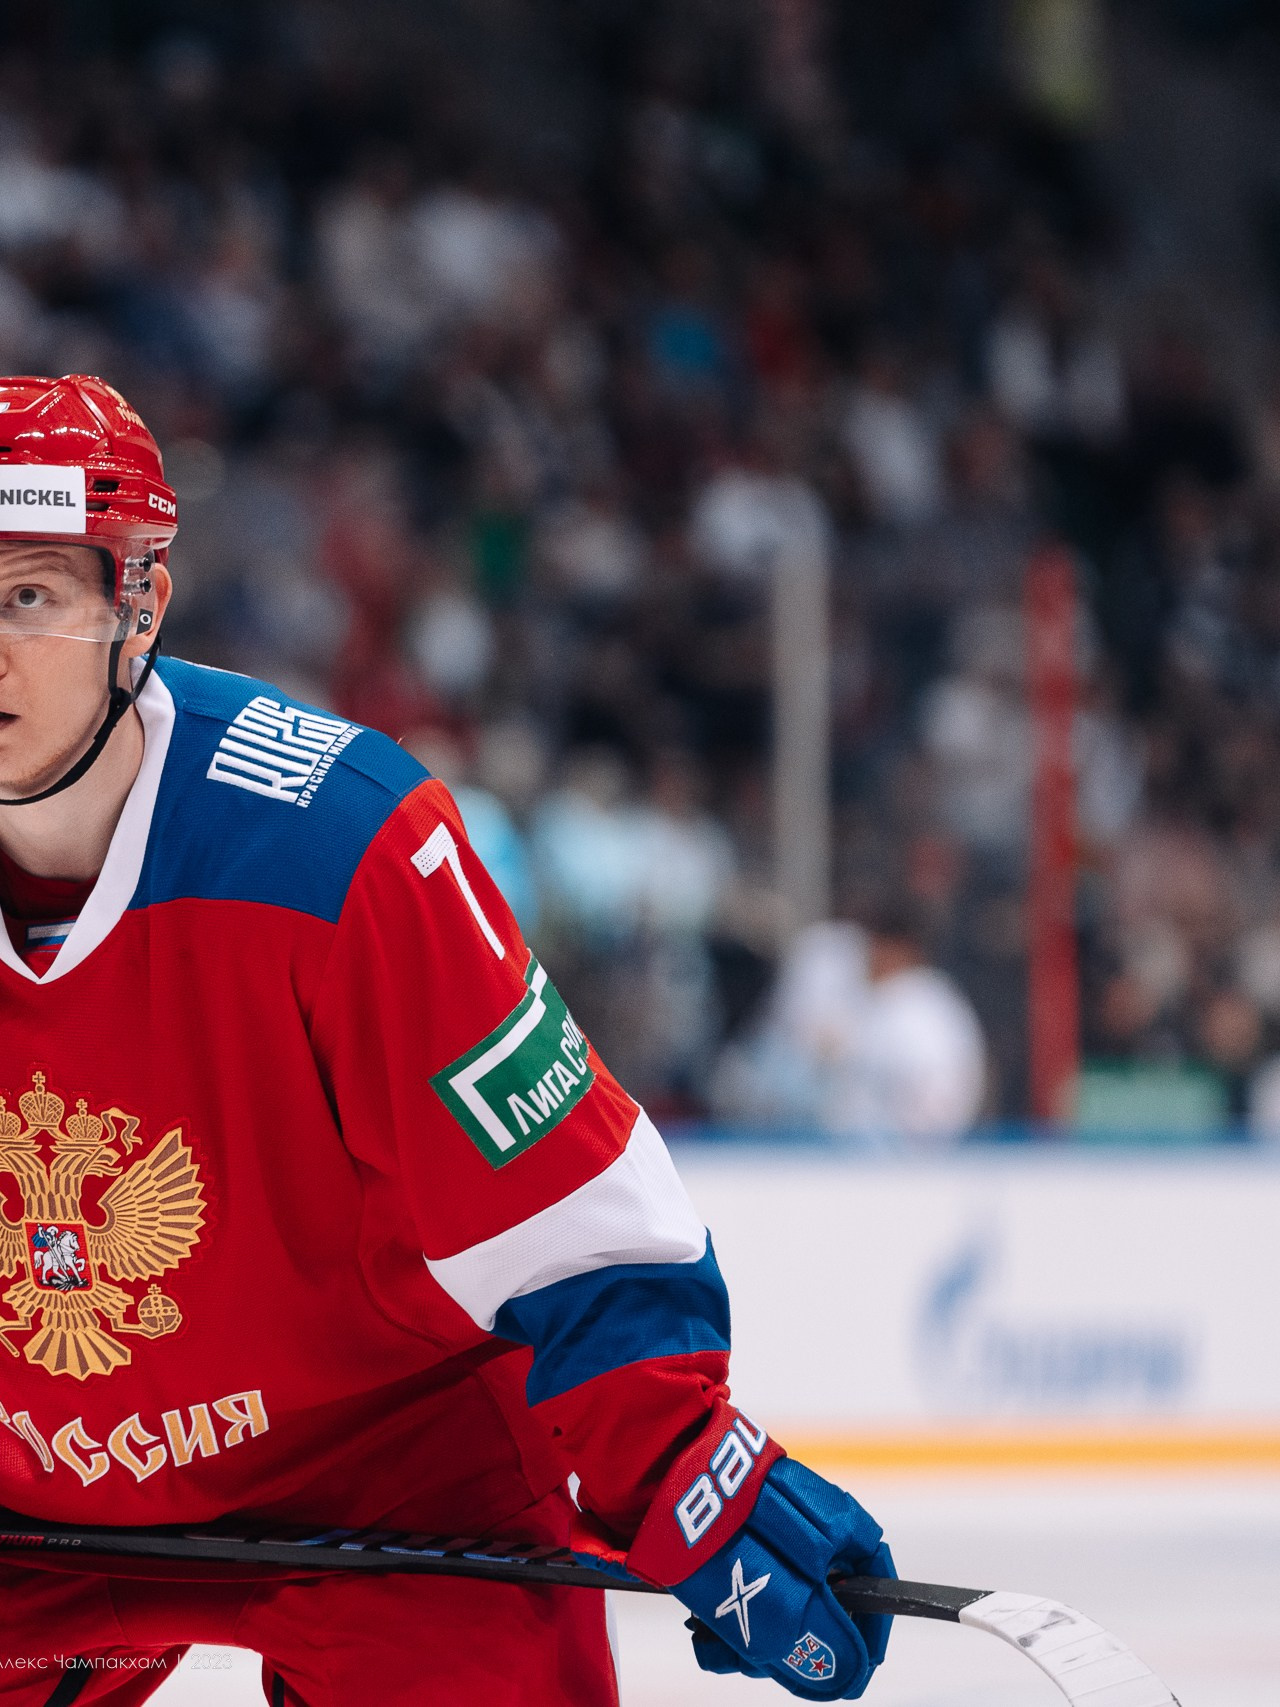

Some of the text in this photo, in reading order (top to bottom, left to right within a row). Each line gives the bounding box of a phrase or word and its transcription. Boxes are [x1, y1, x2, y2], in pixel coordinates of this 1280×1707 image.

[148, 492, 177, 517] CCM
[297, 754, 336, 808] КРАСНАЯ
[410, 822, 505, 960] 7
[506, 1060, 580, 1135] ЛИГА
[47, 1537, 82, 1547] PRO
[787, 1637, 819, 1667] СКА
